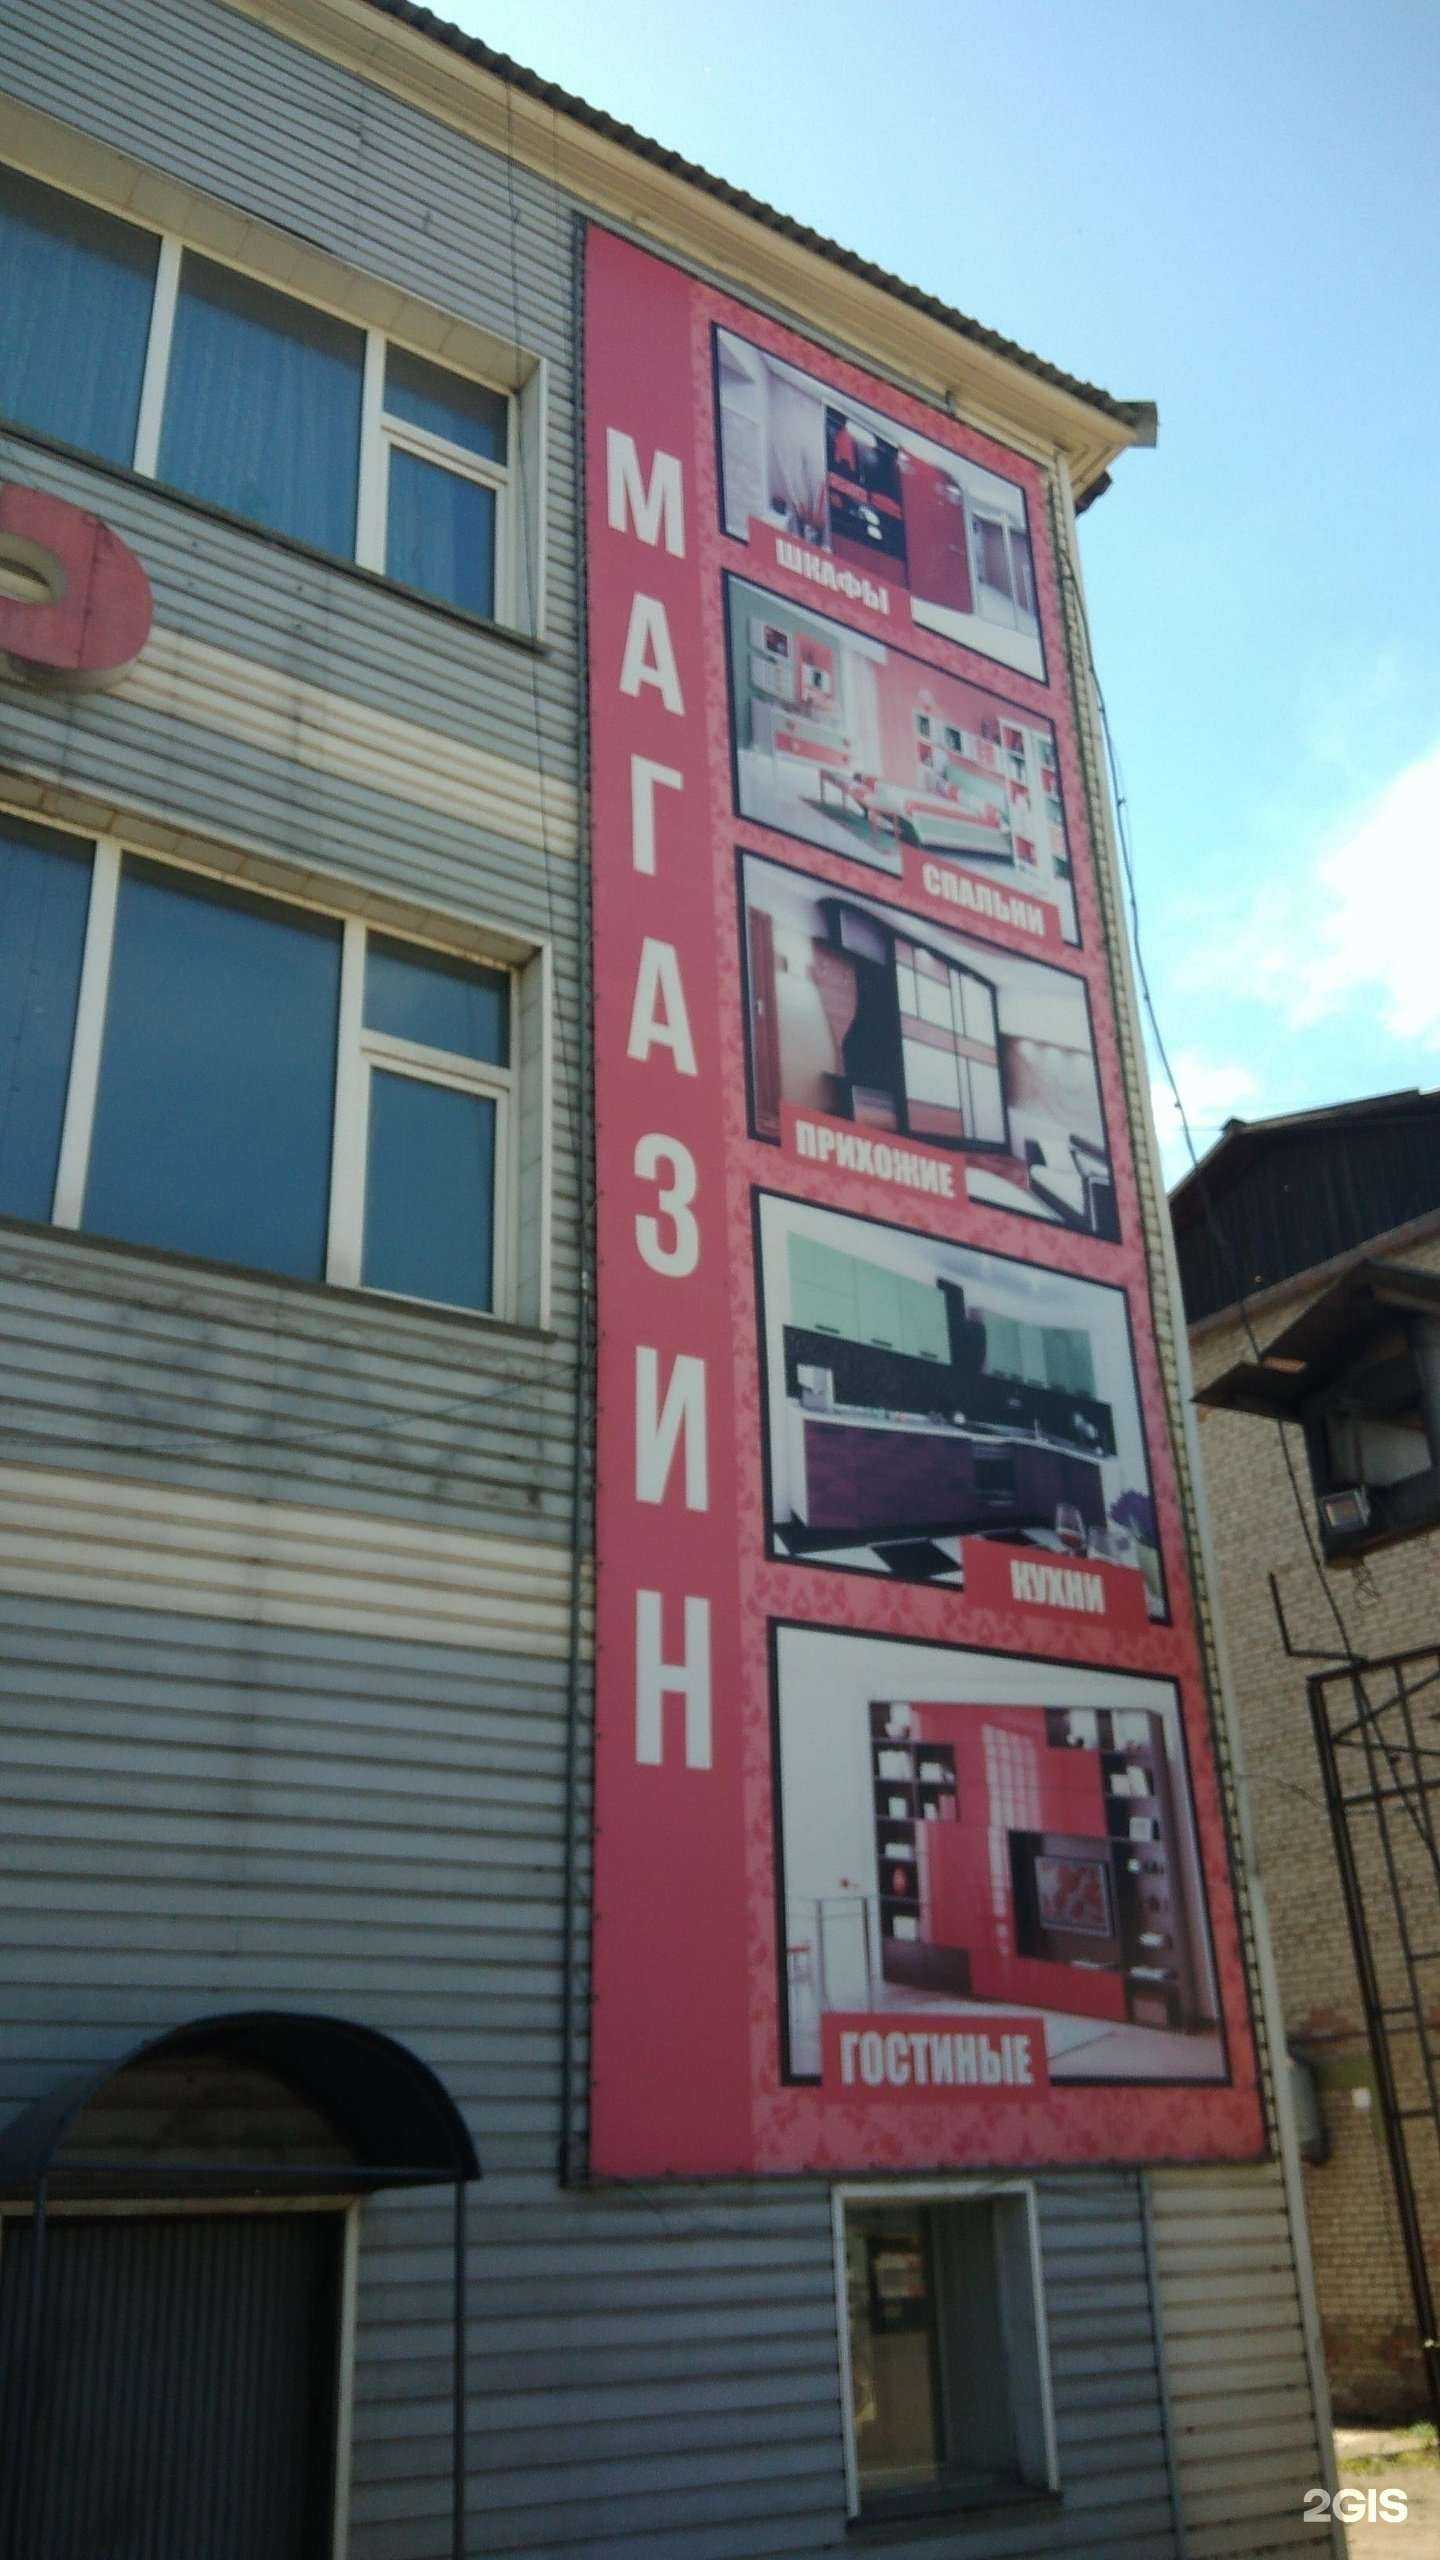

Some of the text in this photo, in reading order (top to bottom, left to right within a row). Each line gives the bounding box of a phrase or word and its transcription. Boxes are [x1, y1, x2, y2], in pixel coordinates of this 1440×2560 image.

[774, 538, 890, 614] ШКАФЫ
[922, 861, 1046, 936] СПАЛЬНИ
[605, 427, 714, 1770] МАГАЗИН
[795, 1119, 956, 1199] ПРИХОЖИЕ
[1010, 1559, 1106, 1615] КУХНИ
[840, 2031, 1033, 2086] ГОСТИНЫЕ
